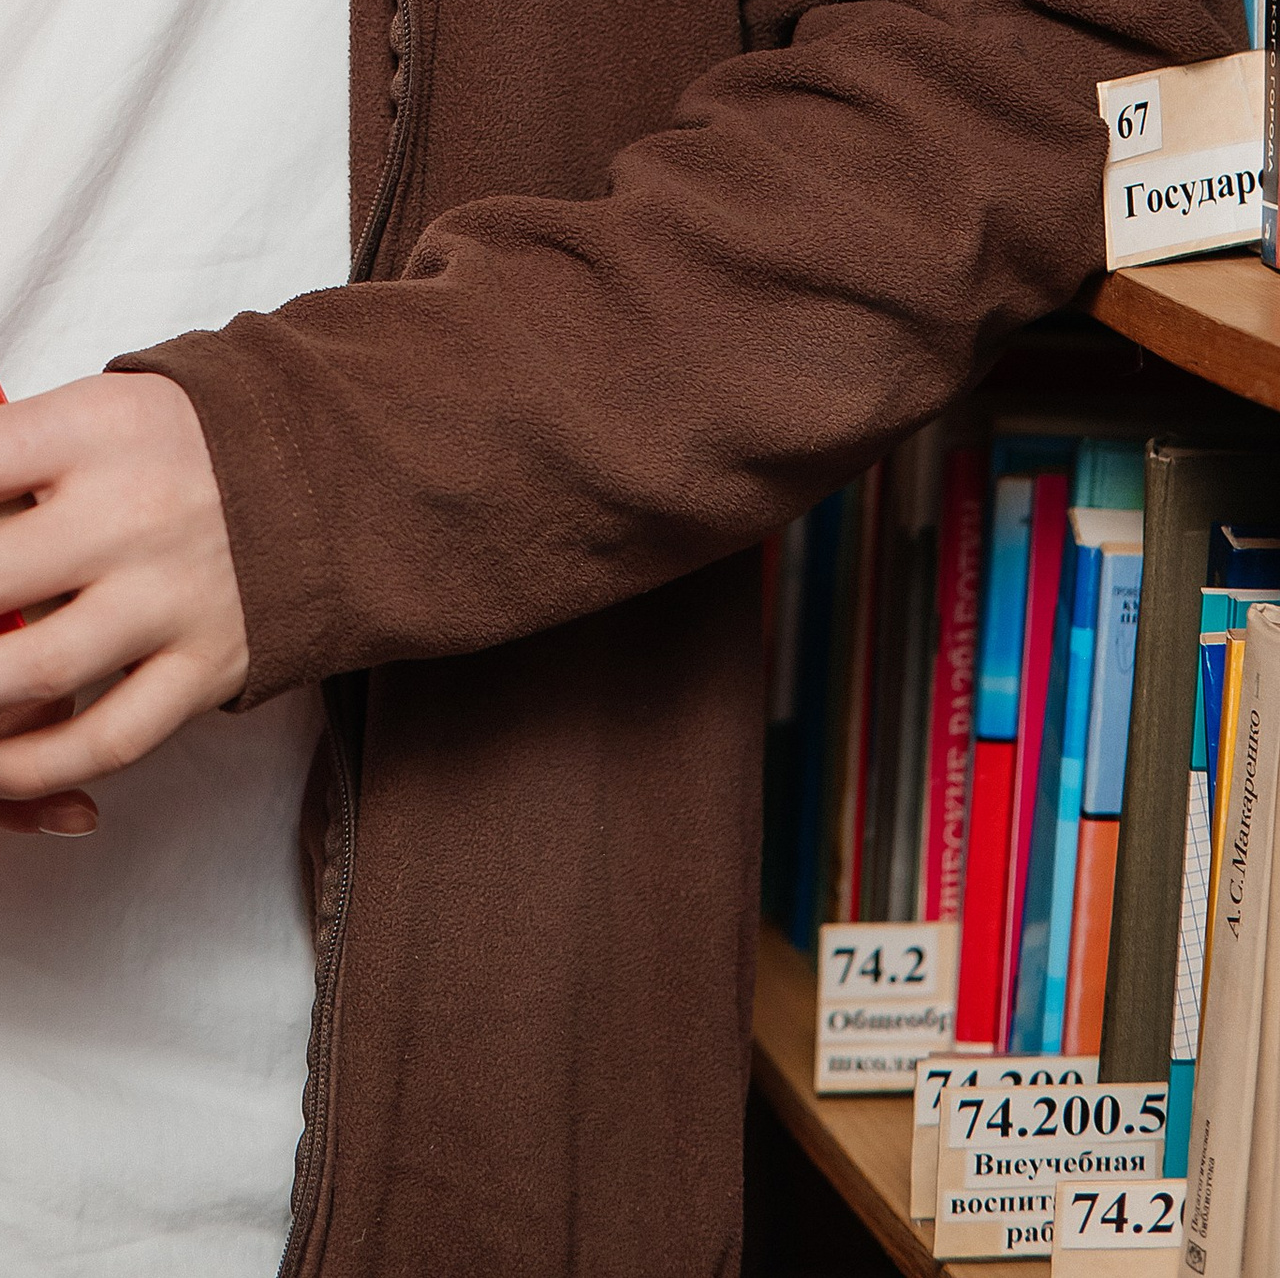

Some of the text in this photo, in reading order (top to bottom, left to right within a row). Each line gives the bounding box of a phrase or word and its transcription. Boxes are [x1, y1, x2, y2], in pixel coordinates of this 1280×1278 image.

[1116, 100, 1150, 140] 67
[1267, 75, 1277, 173] ГОРОДА
[832, 946, 925, 984] 74.2
[957, 1093, 1167, 1140] 74.200.5
[974, 1150, 1146, 1180] Внеучебная
[950, 1194, 1055, 1215] воспит
[1071, 1191, 1187, 1234] 74.2
